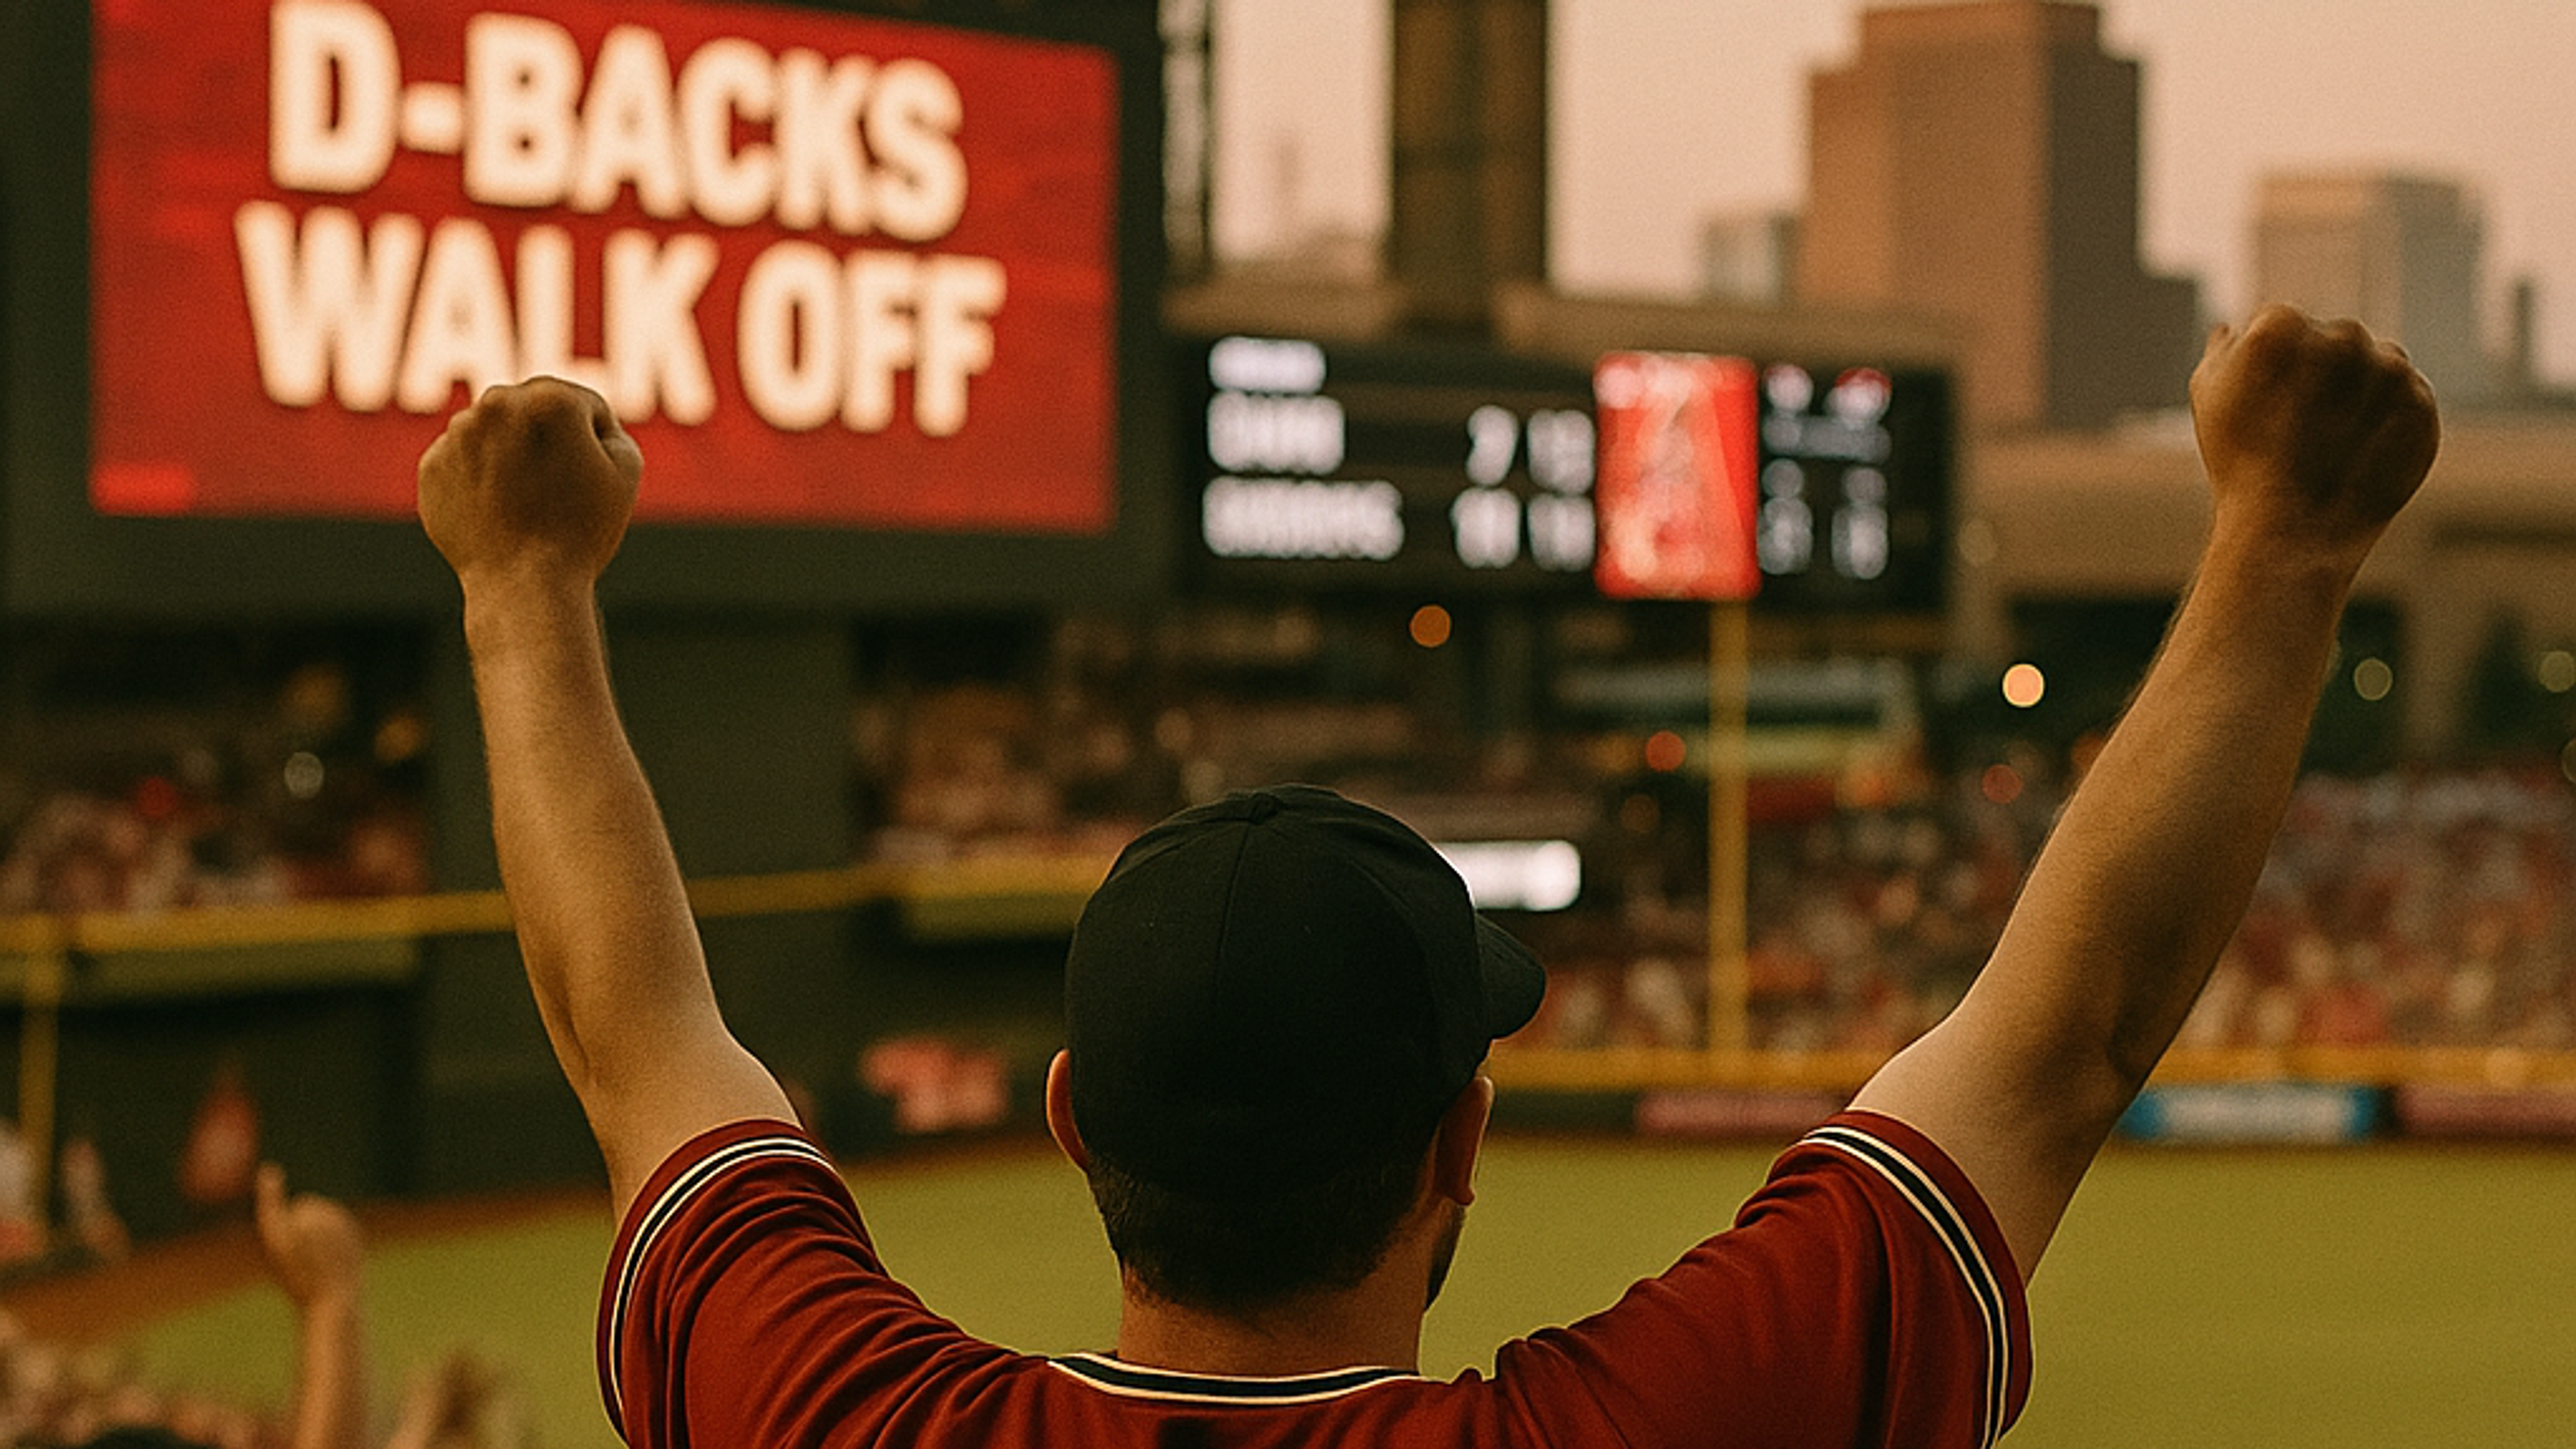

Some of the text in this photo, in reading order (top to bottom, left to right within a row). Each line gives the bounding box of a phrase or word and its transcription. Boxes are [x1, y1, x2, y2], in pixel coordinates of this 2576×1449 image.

[270, 0, 967, 240] D-BACKS
[235, 201, 1008, 437] WALK OFF
